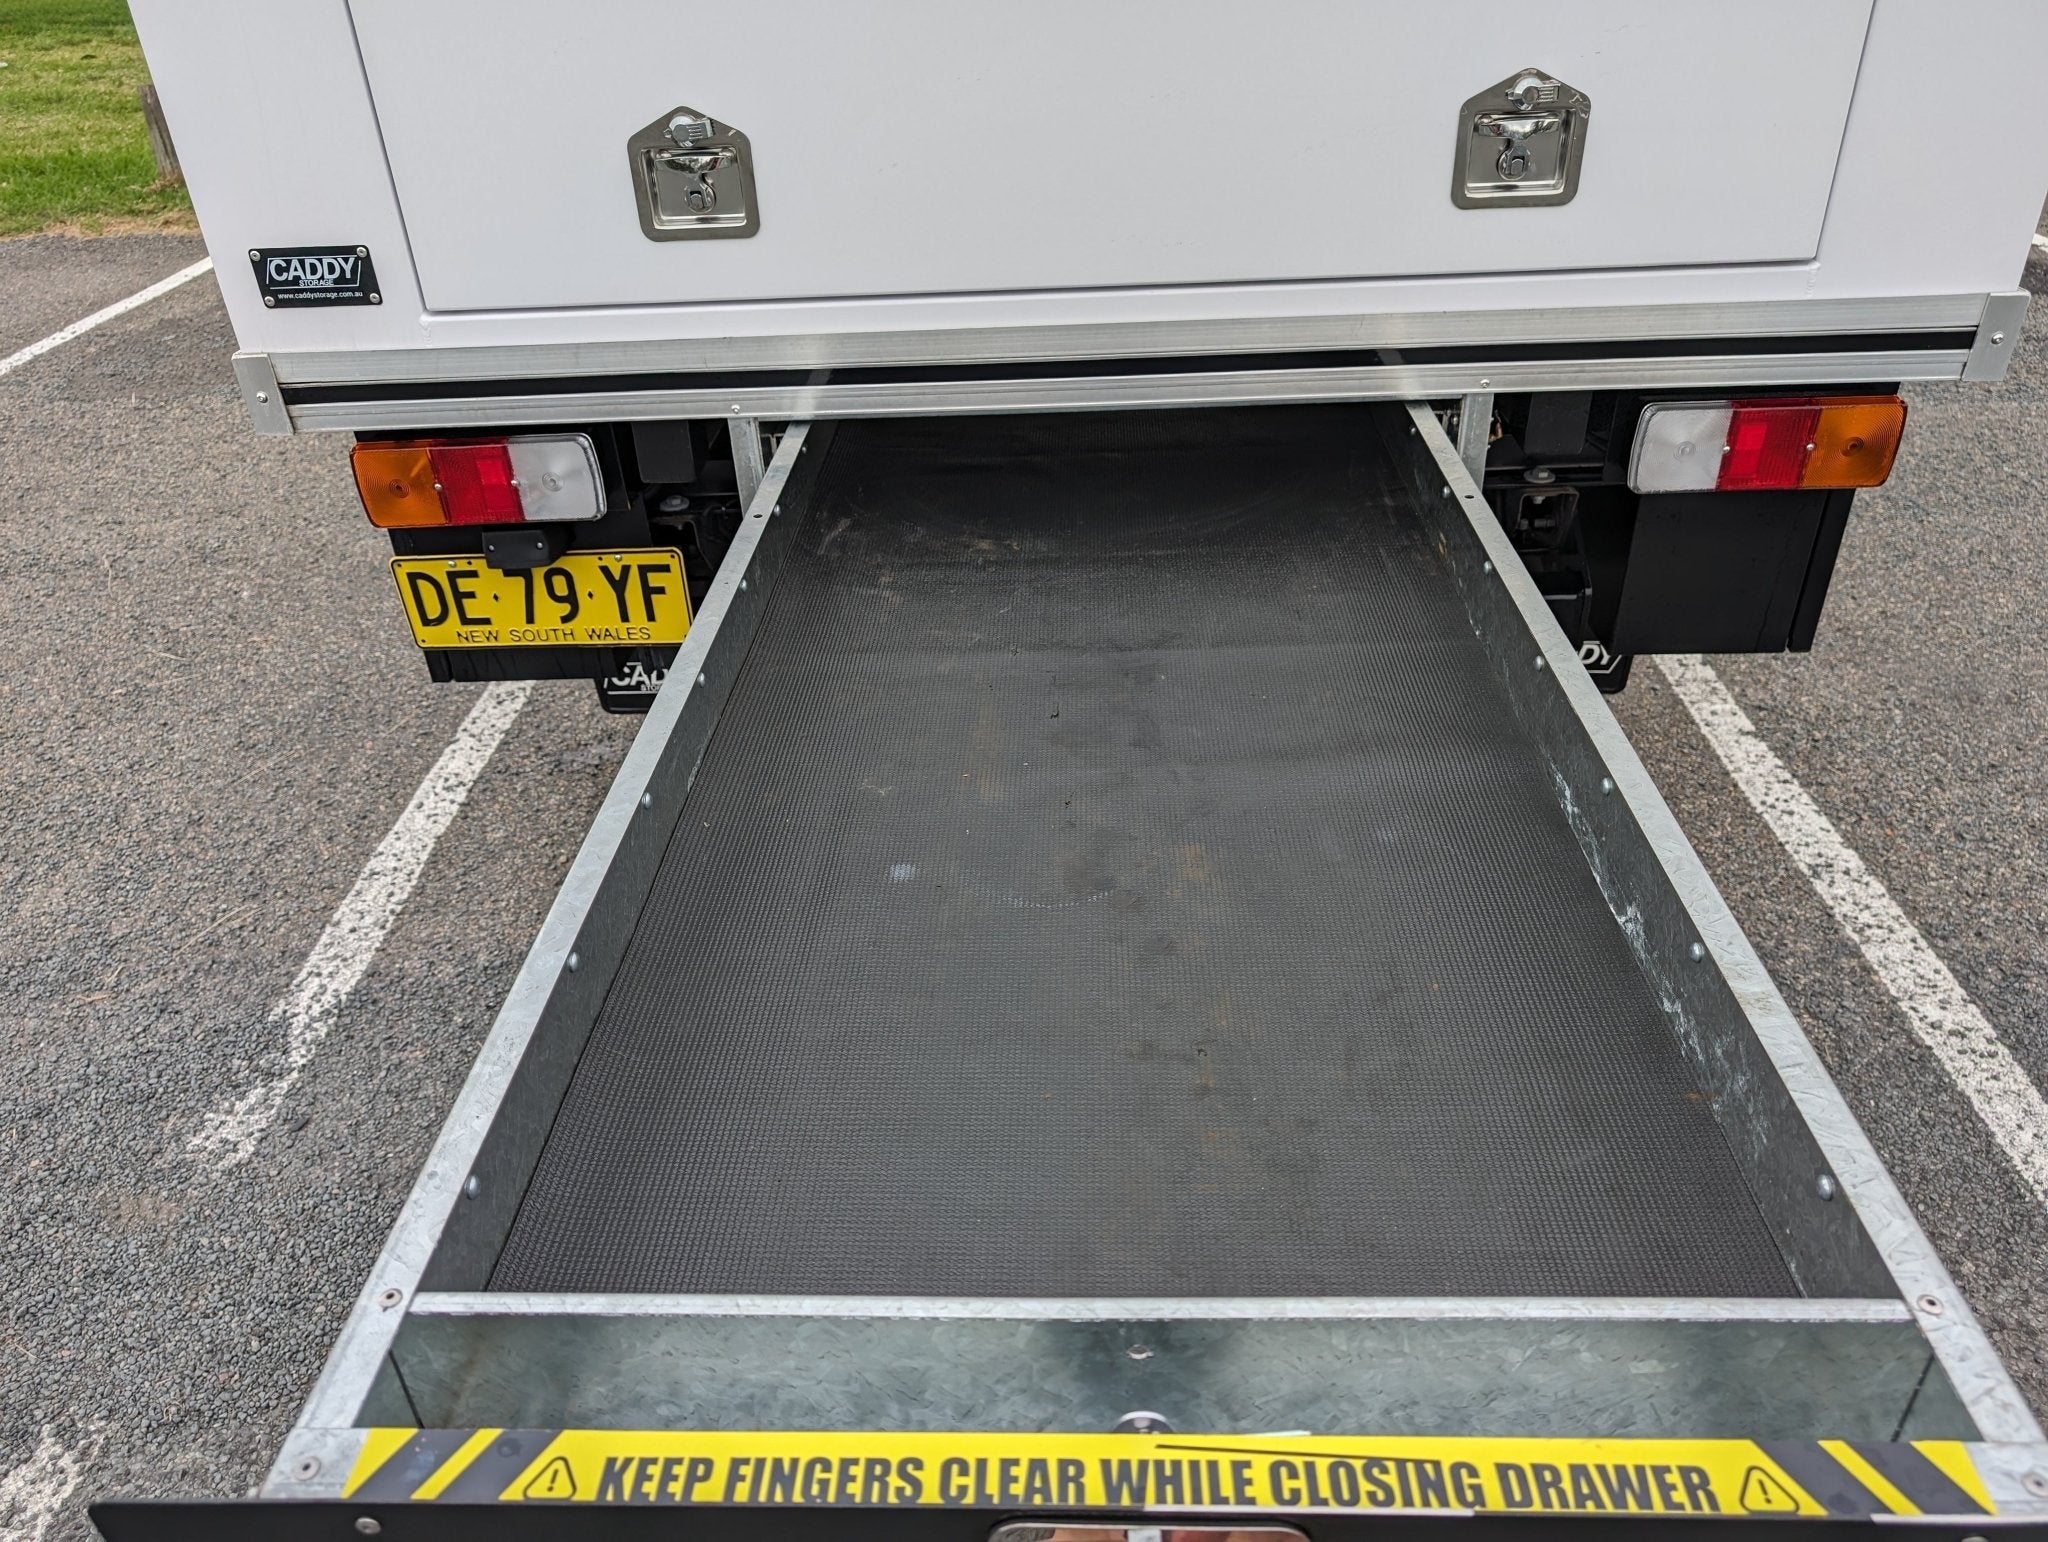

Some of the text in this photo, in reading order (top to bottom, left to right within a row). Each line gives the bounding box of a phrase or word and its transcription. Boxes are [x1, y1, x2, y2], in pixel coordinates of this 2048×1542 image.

[269, 257, 355, 281] CADDY
[298, 279, 335, 287] STORAGE
[277, 291, 363, 300] www.caddystorage.com.au
[456, 626, 651, 643] NEW SOUTH WALES
[593, 1457, 1720, 1513] KEEP FINGERS CLEAR WHILE CLOSING DRAWER
